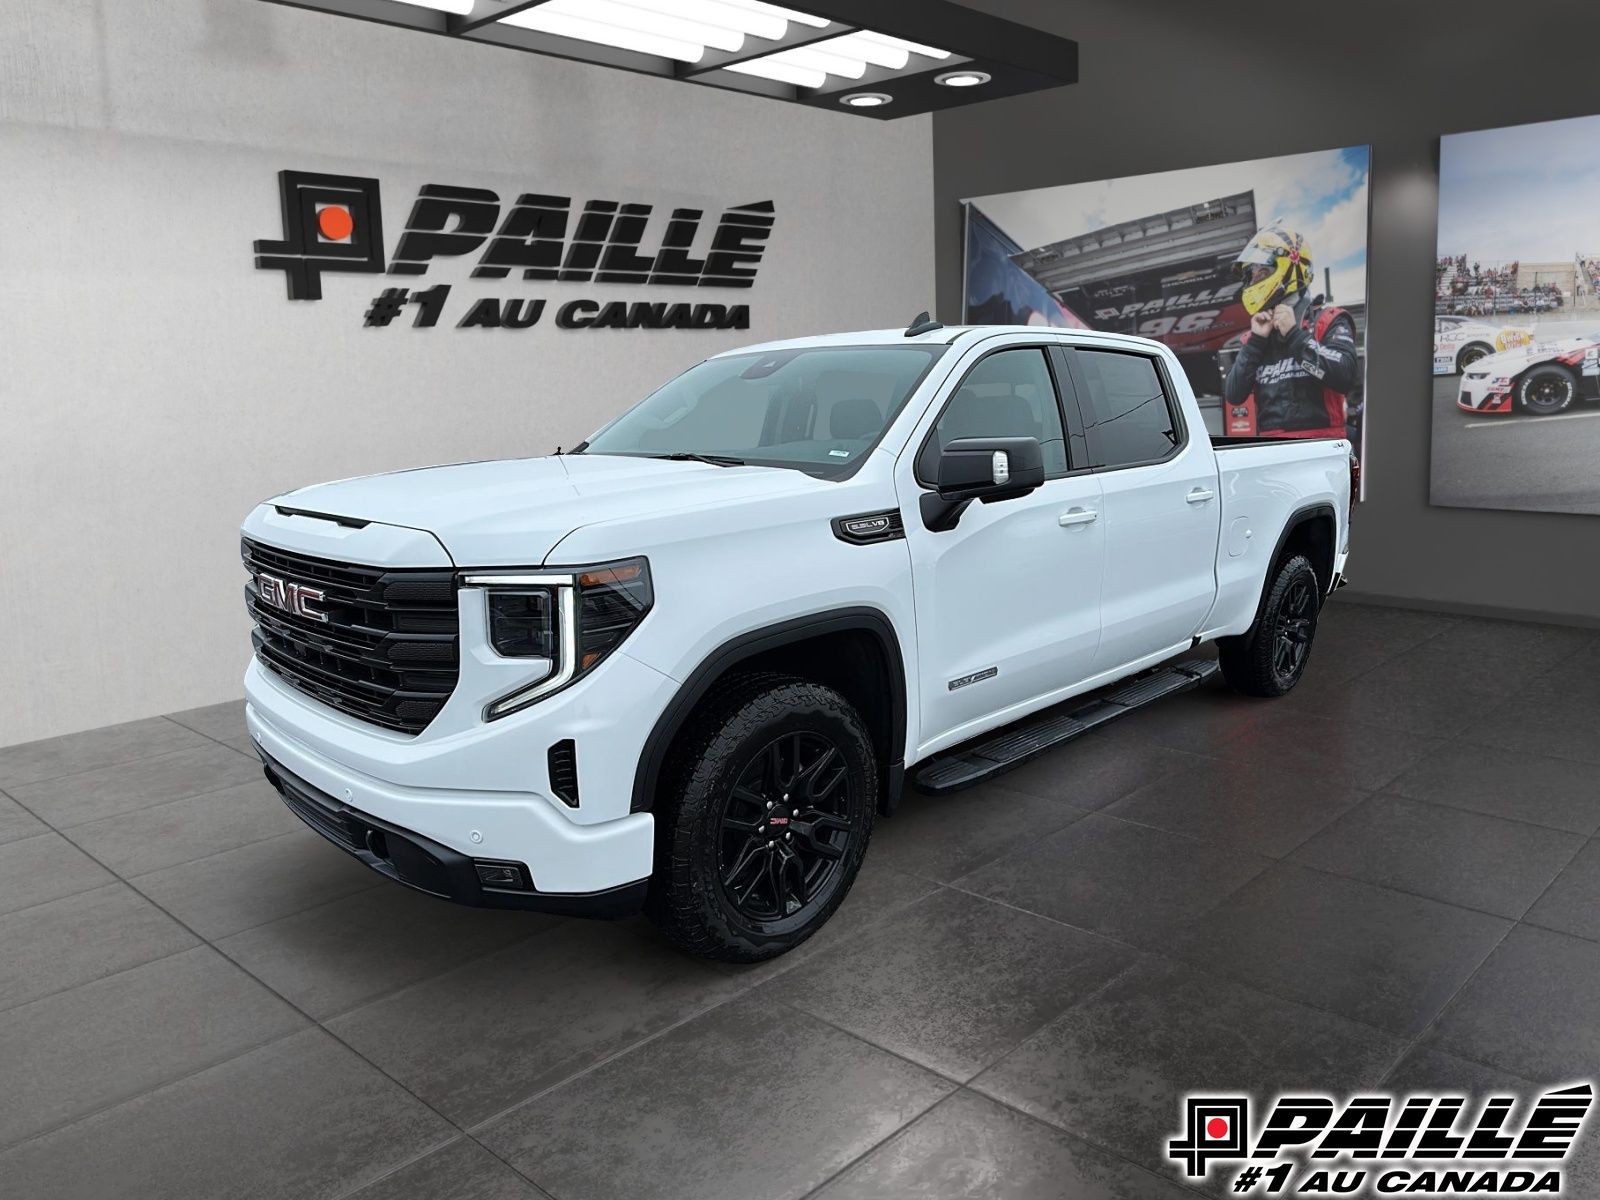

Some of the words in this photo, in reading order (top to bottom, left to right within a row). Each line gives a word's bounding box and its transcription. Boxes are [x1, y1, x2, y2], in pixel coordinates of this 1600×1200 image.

[386, 184, 775, 288] PAILLÉ
[363, 284, 452, 328] #1
[456, 298, 547, 329] AU
[556, 299, 750, 330] CANADA
[1137, 309, 1221, 338] 96
[257, 572, 329, 623] GMC
